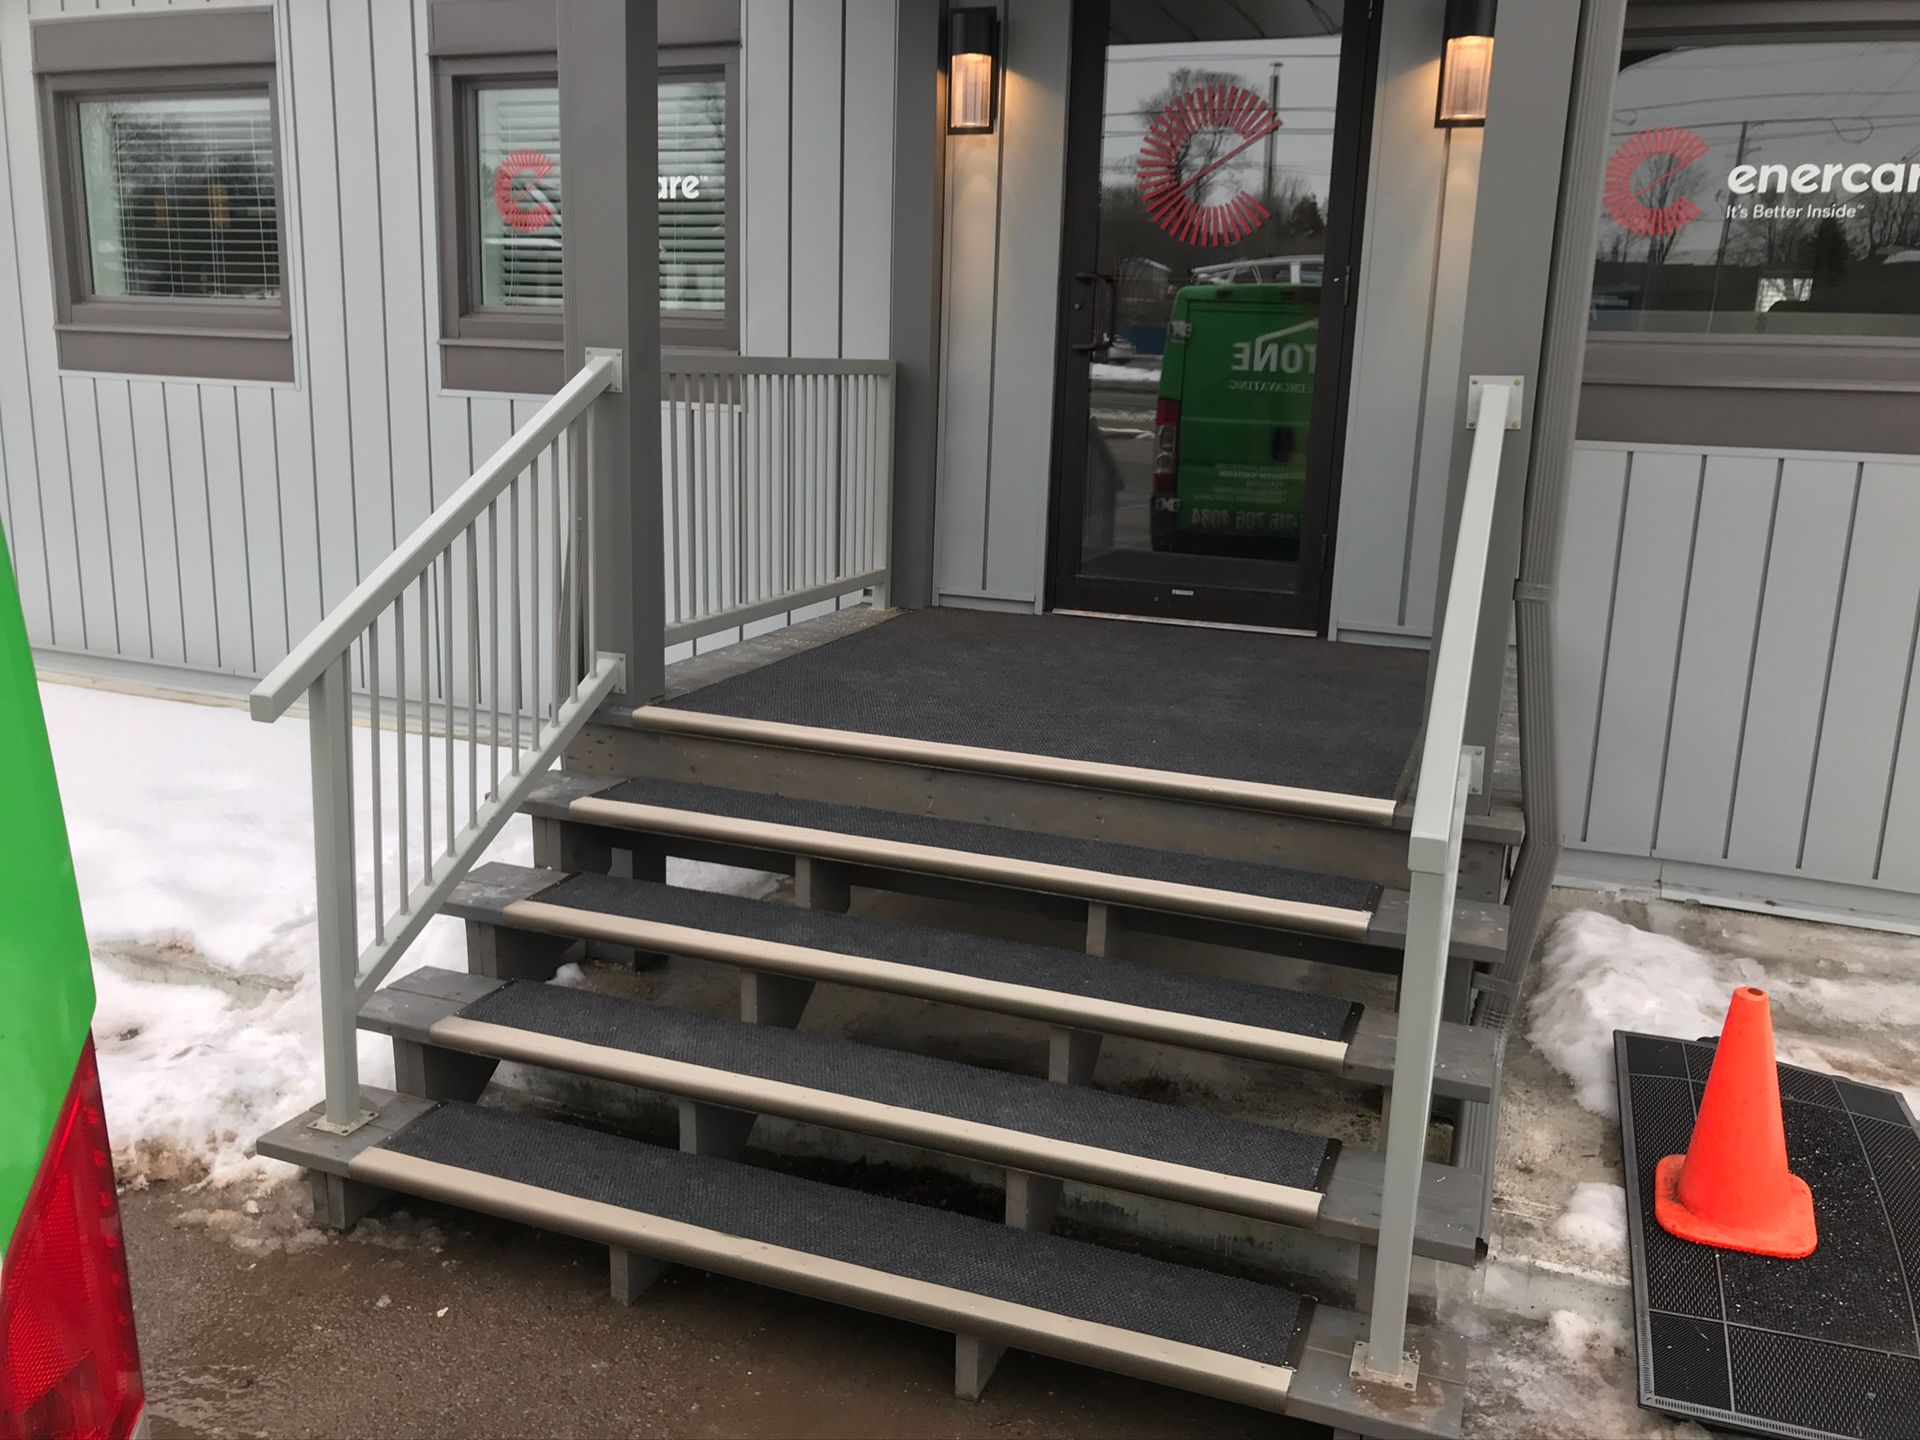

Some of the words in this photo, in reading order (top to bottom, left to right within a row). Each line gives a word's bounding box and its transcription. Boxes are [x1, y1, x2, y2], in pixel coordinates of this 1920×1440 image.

[1726, 204, 1749, 219] It's
[1752, 204, 1803, 219] Better
[1806, 203, 1857, 219] Inside
